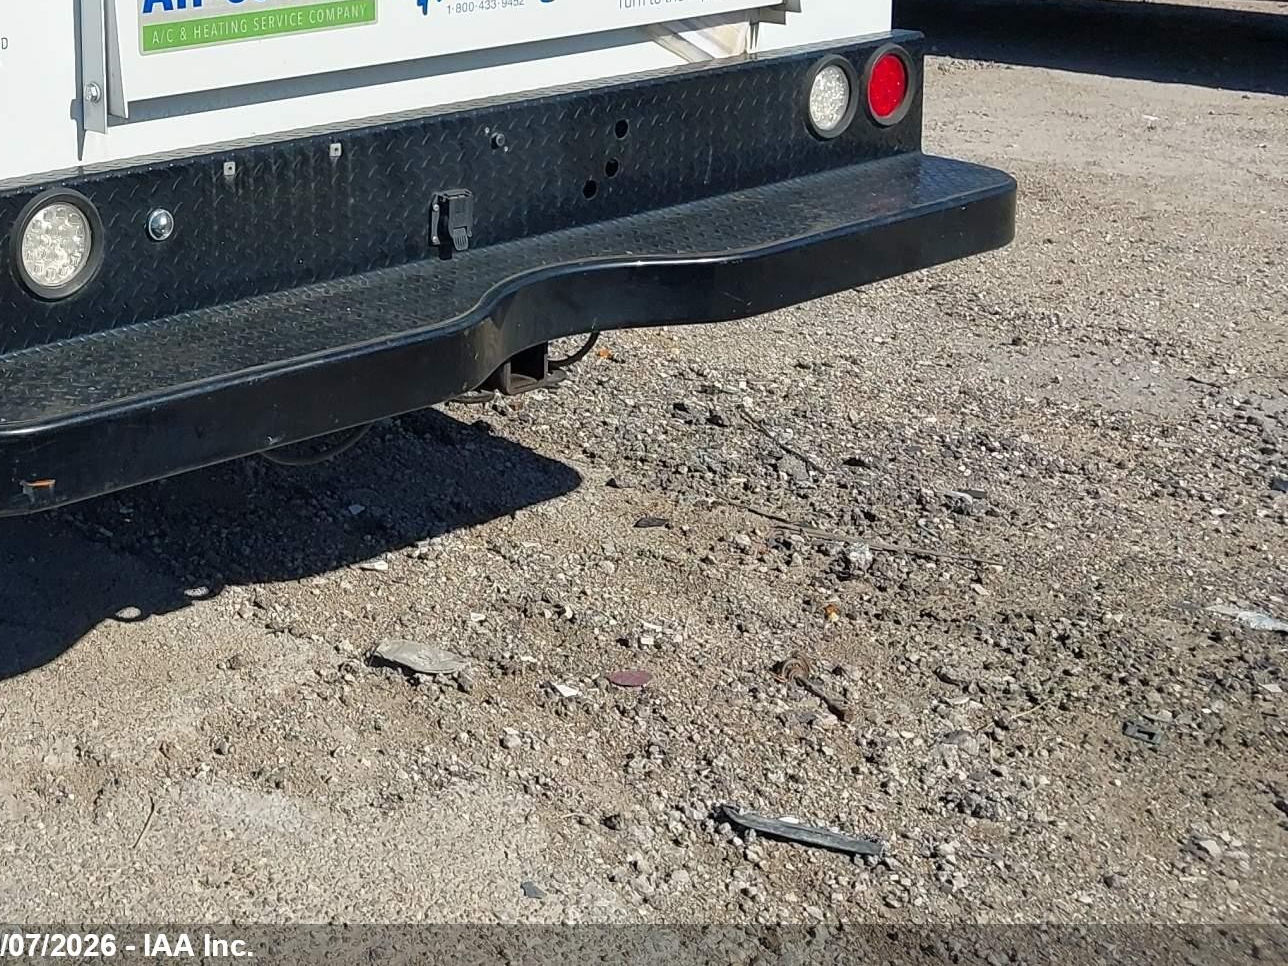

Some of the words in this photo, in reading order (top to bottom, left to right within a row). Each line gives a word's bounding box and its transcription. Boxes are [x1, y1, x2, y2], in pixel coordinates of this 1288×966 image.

[152, 28, 174, 44] A/C
[179, 26, 187, 41] &
[194, 19, 247, 39] HEATING
[253, 12, 304, 33] SERVICE
[309, 4, 367, 24] COMPANY
